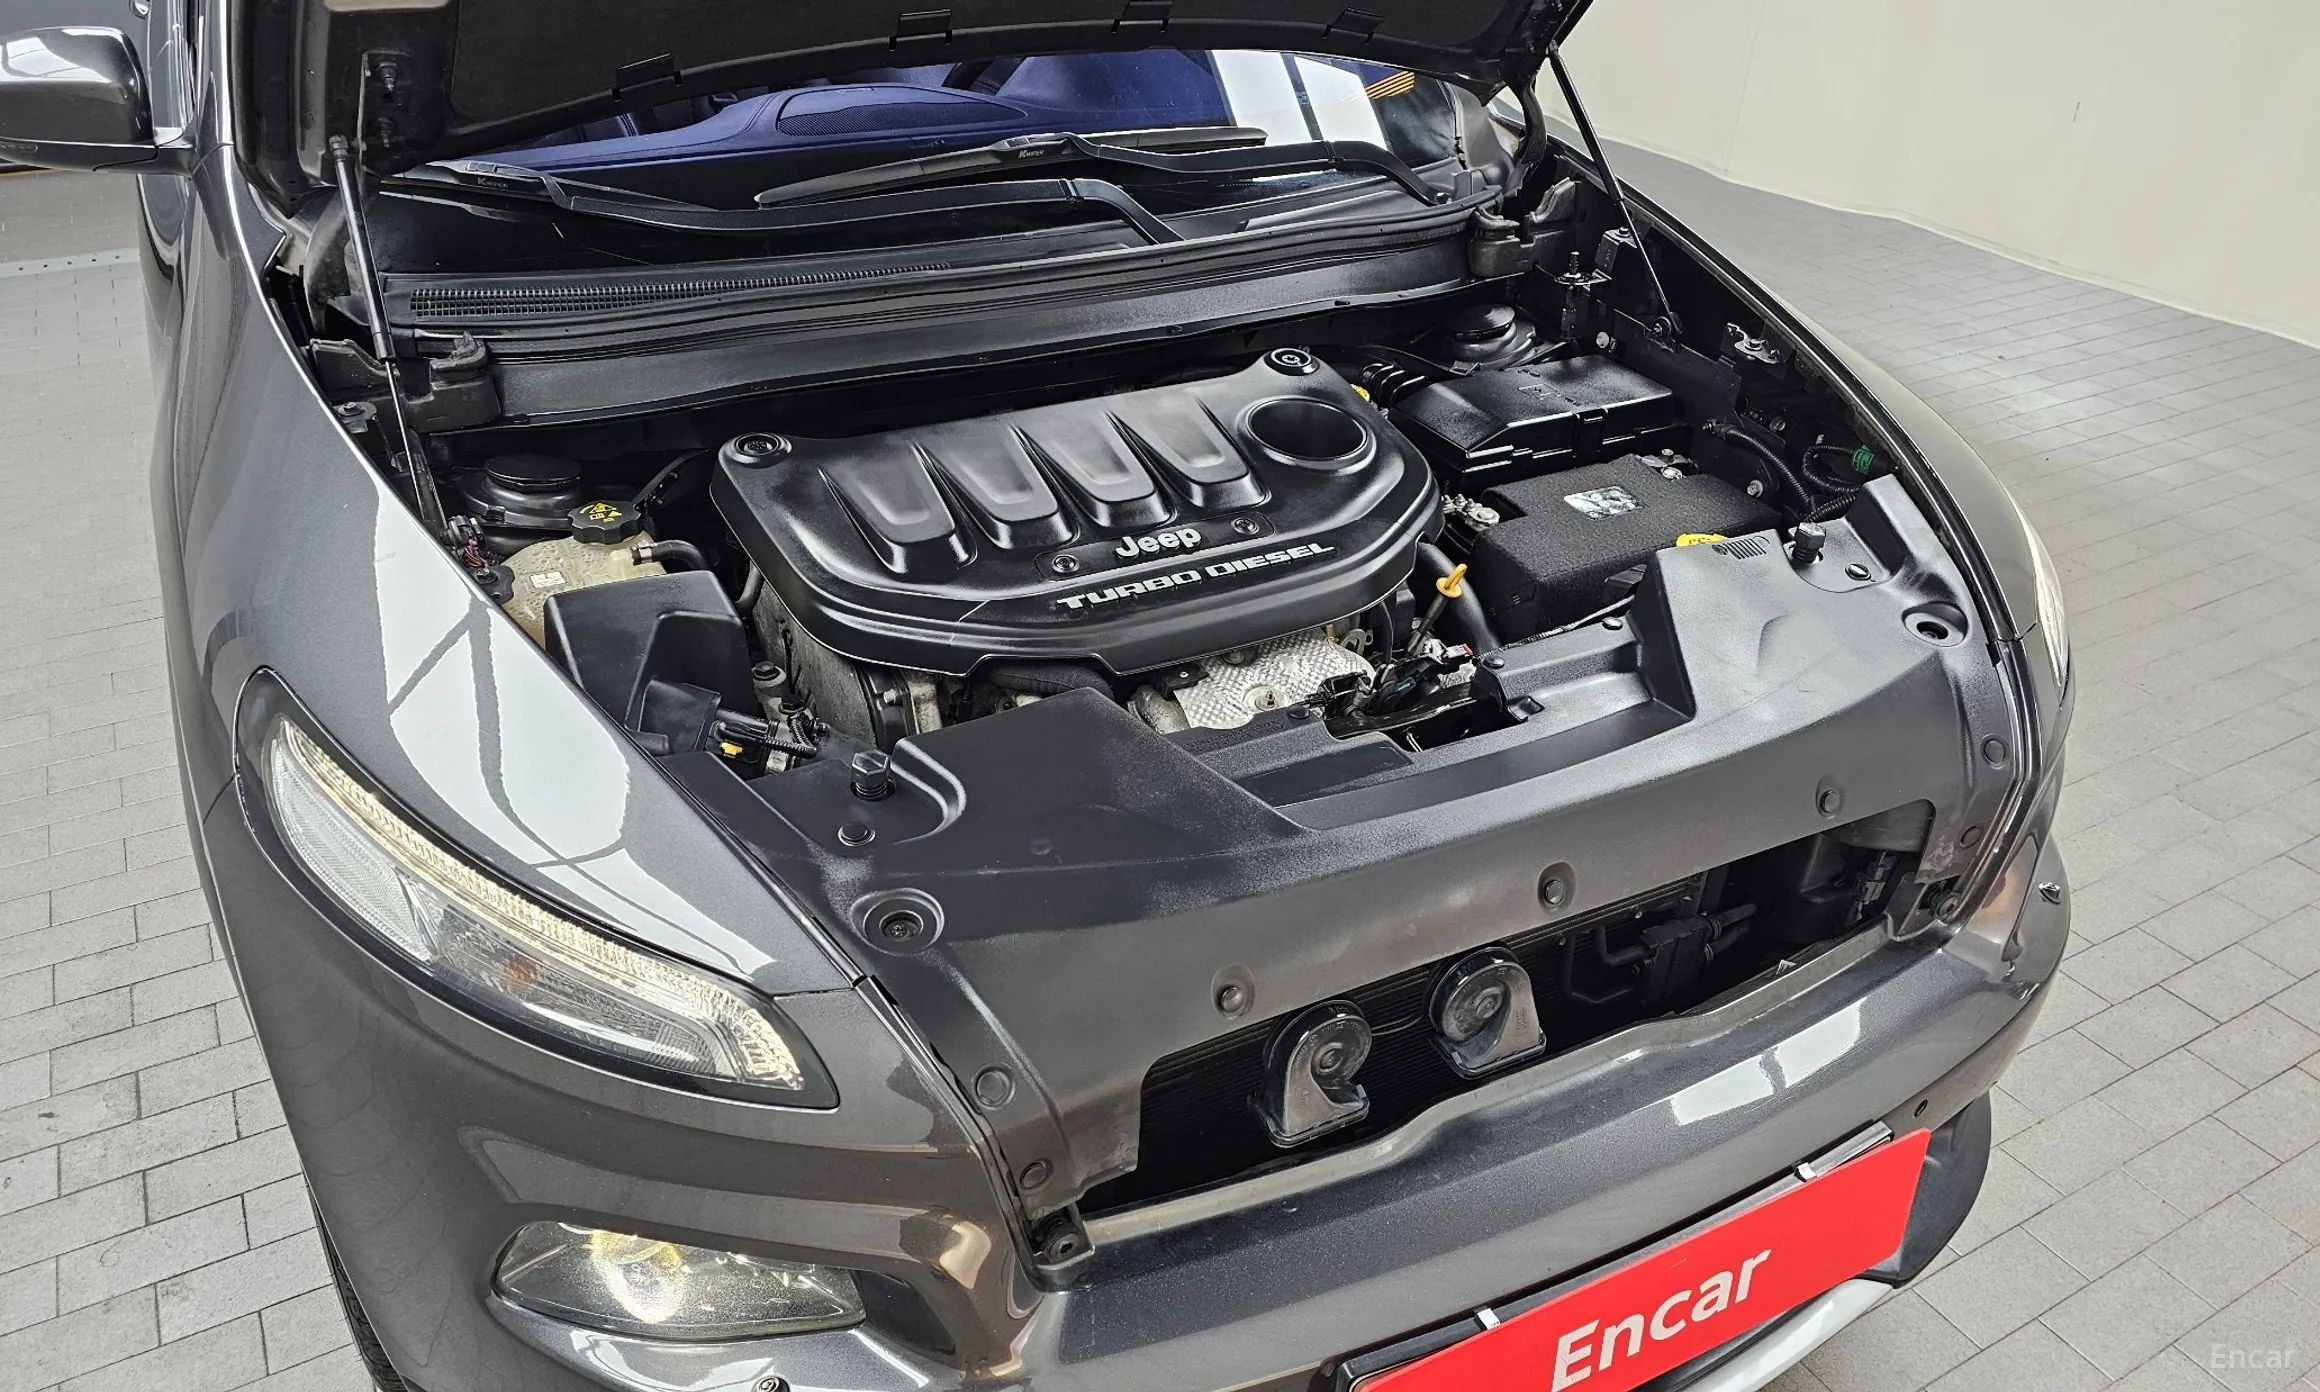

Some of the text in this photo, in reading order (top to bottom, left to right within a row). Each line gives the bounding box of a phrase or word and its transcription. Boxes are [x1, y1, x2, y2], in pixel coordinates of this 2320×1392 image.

[1057, 543, 1335, 609] TURBO DIESEL
[1115, 528, 1201, 558] Jeep
[1551, 1249, 1771, 1392] Encar
